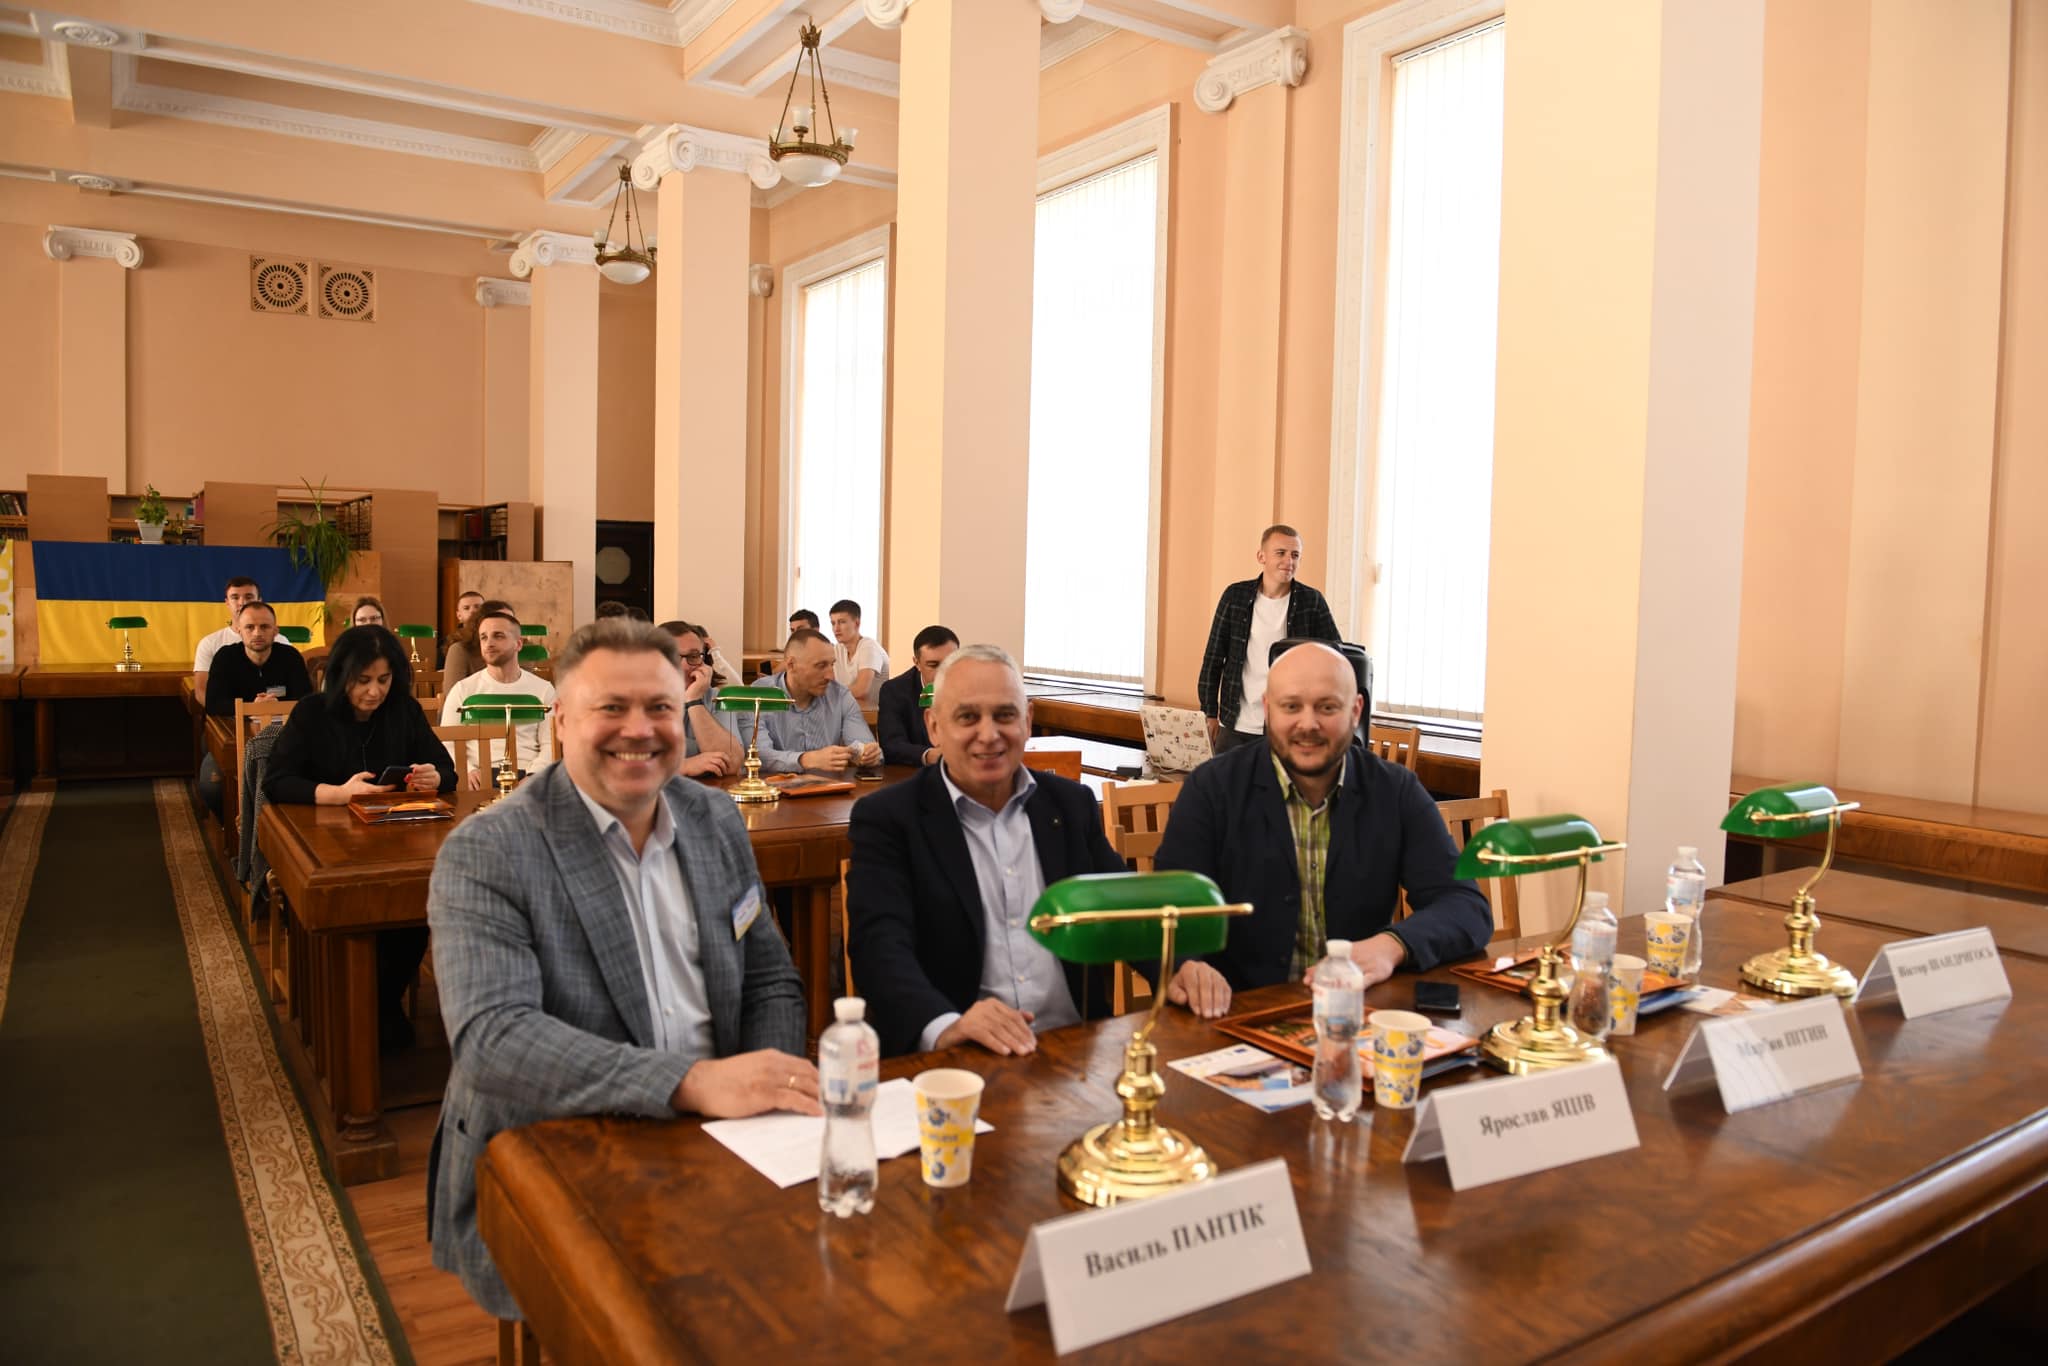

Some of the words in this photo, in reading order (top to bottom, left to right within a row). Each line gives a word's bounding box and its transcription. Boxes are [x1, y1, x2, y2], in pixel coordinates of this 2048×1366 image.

[1480, 1107, 1550, 1138] Ярослав
[1551, 1093, 1597, 1119] ЯЦІВ
[1085, 1238, 1168, 1279] Василь
[1172, 1203, 1266, 1252] ПАНТІК
